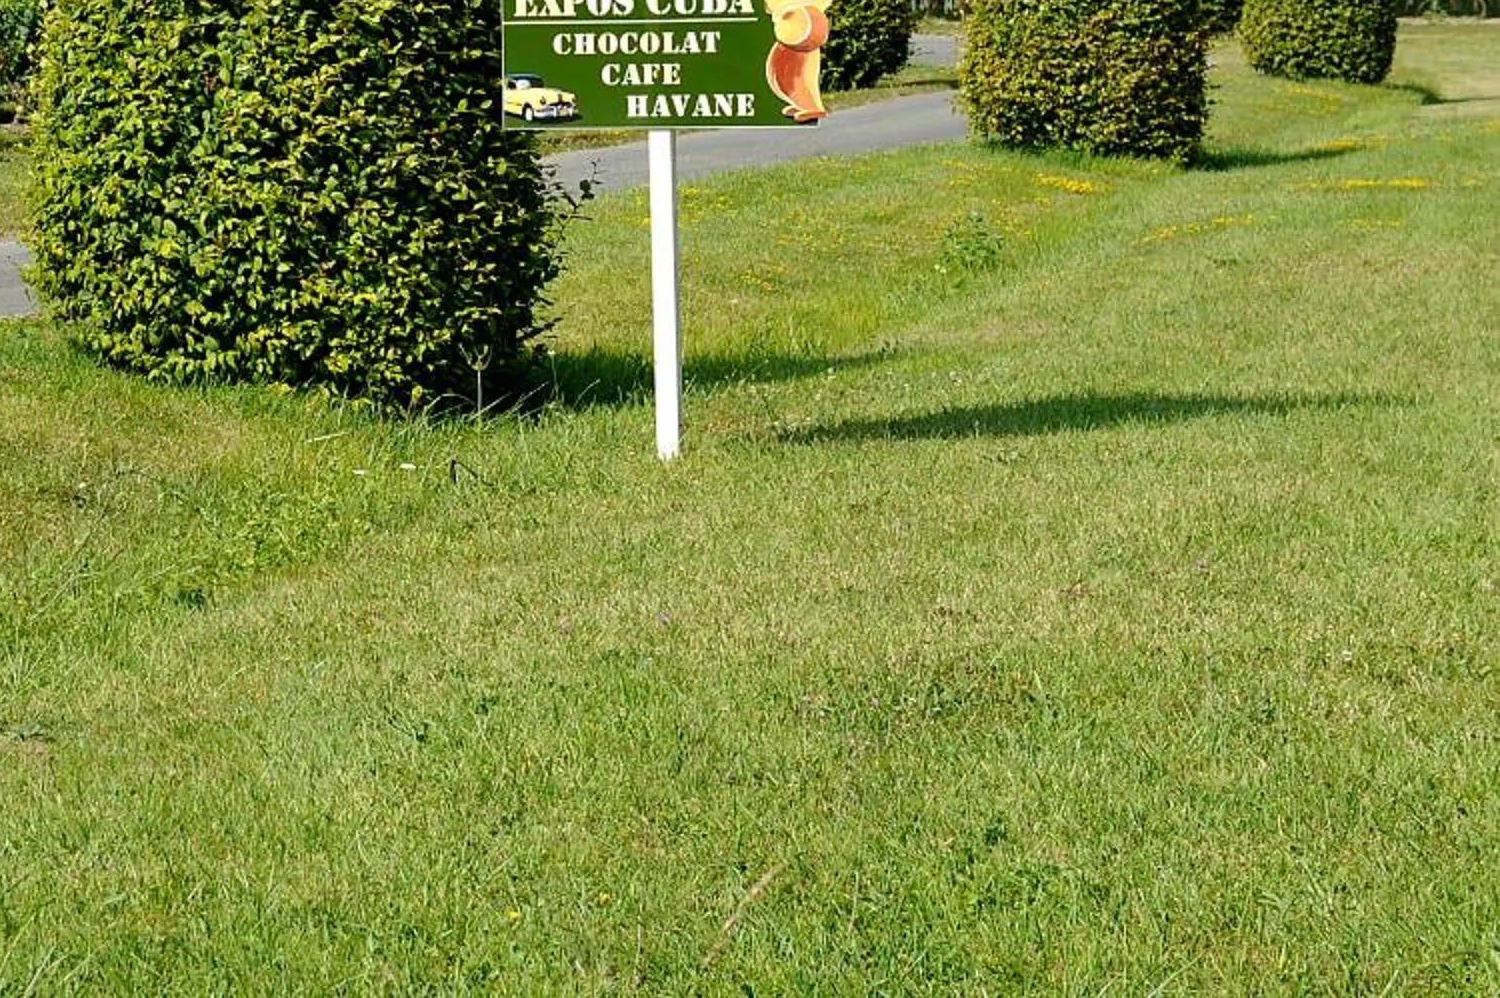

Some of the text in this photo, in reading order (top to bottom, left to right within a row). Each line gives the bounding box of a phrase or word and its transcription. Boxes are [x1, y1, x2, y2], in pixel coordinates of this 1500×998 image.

[553, 32, 721, 55] CHOCOLAT
[601, 63, 681, 85] CAFE
[627, 94, 755, 118] HAVANE
